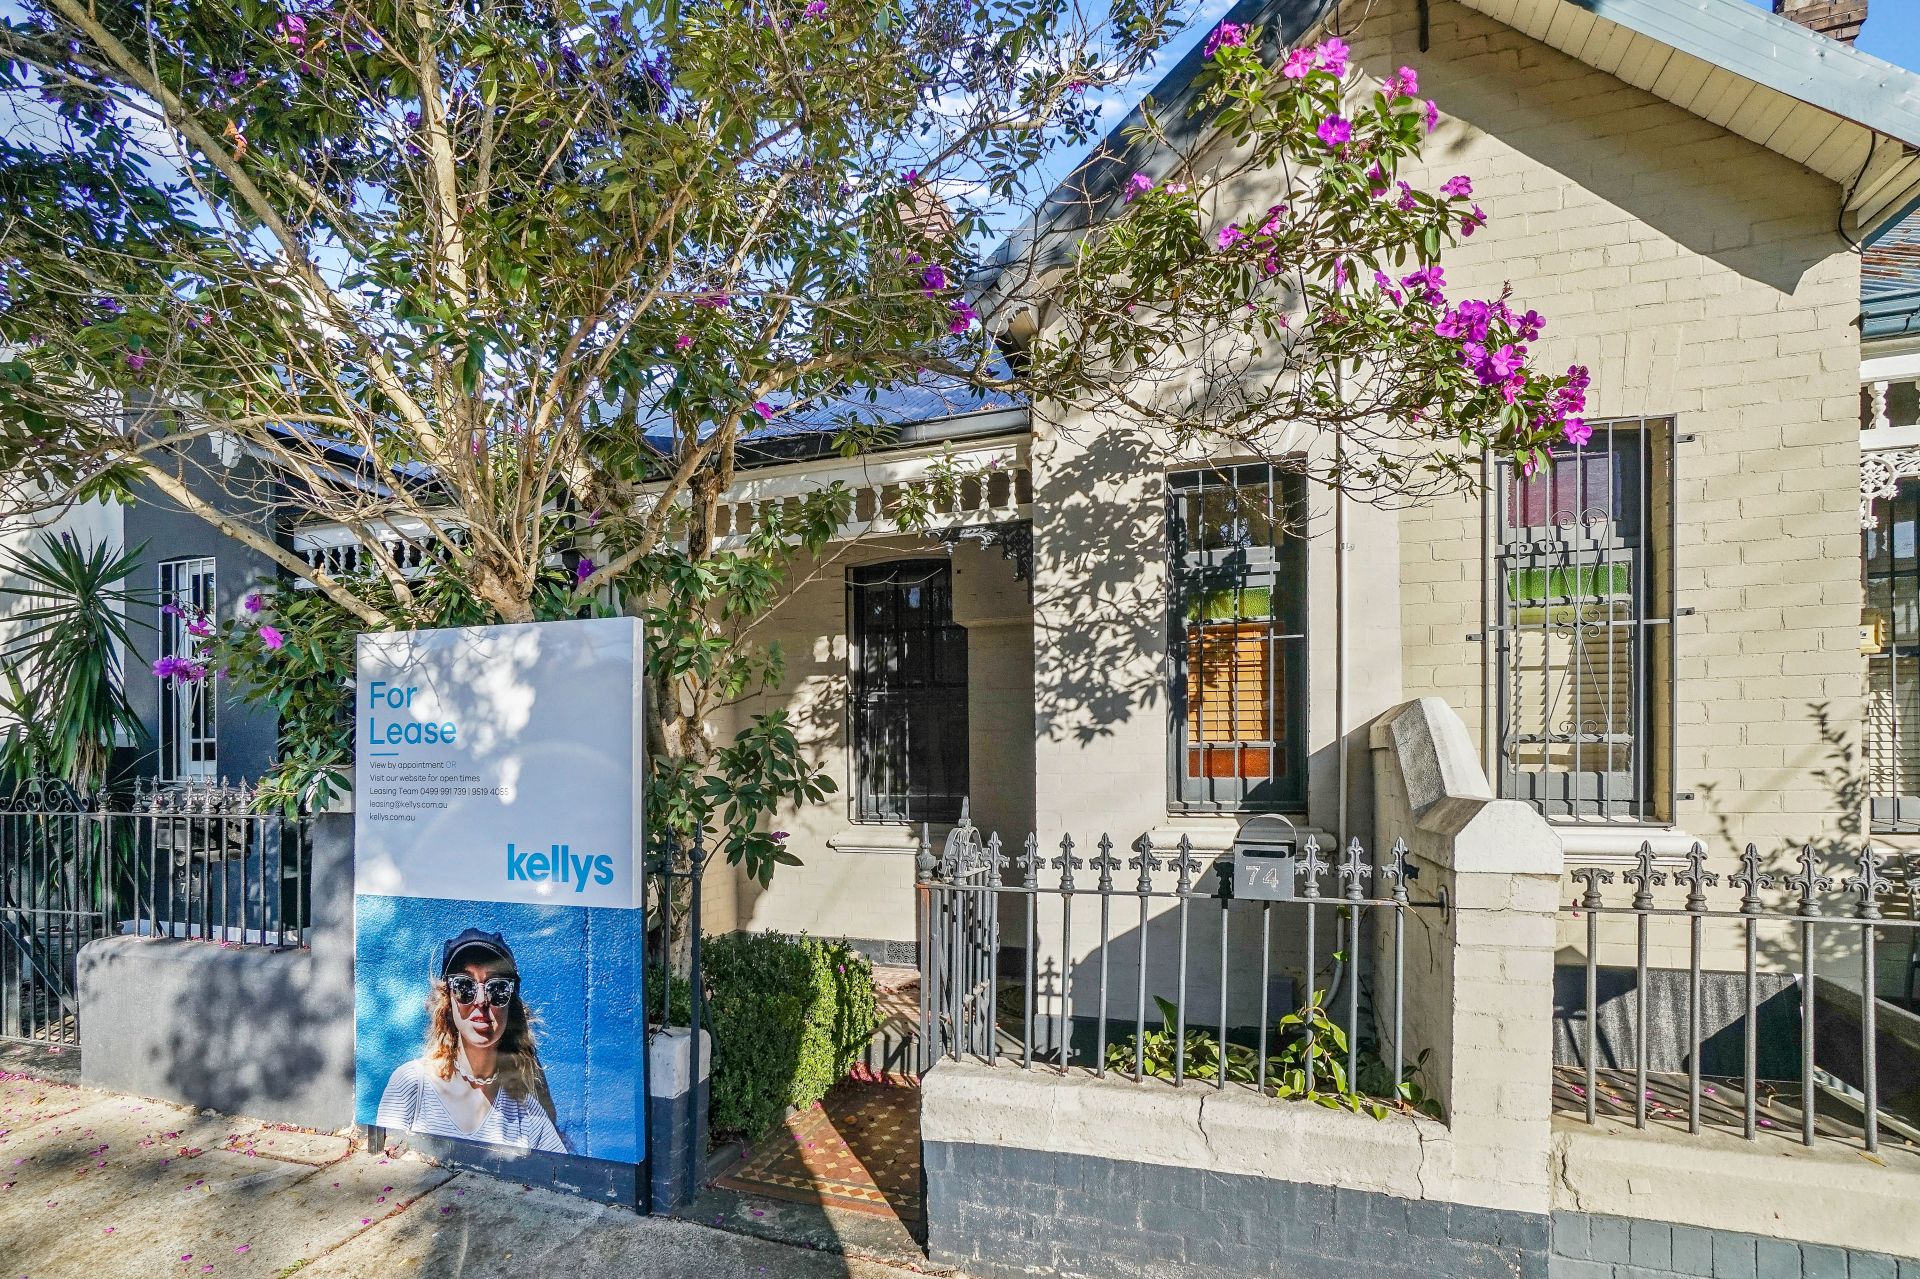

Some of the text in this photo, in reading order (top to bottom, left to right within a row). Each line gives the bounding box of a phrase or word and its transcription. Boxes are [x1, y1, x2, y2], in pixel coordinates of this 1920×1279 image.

[370, 682, 417, 708] For
[370, 718, 456, 744] Lease
[370, 761, 457, 770] View by appointment OR
[370, 774, 385, 782] Visit
[400, 774, 426, 782] website
[427, 773, 438, 782] for
[439, 775, 459, 784] open
[459, 774, 480, 783] times
[369, 787, 397, 796] Leasing
[399, 787, 419, 795] Team
[420, 787, 439, 796] 0499
[440, 787, 452, 796] 991
[453, 787, 467, 796] 739
[471, 787, 489, 796] 9519
[369, 800, 448, 809] leasing@kellys.com.au
[369, 812, 416, 822] kellys.com.au
[507, 843, 614, 893] kellys
[1245, 865, 1279, 887] 74
